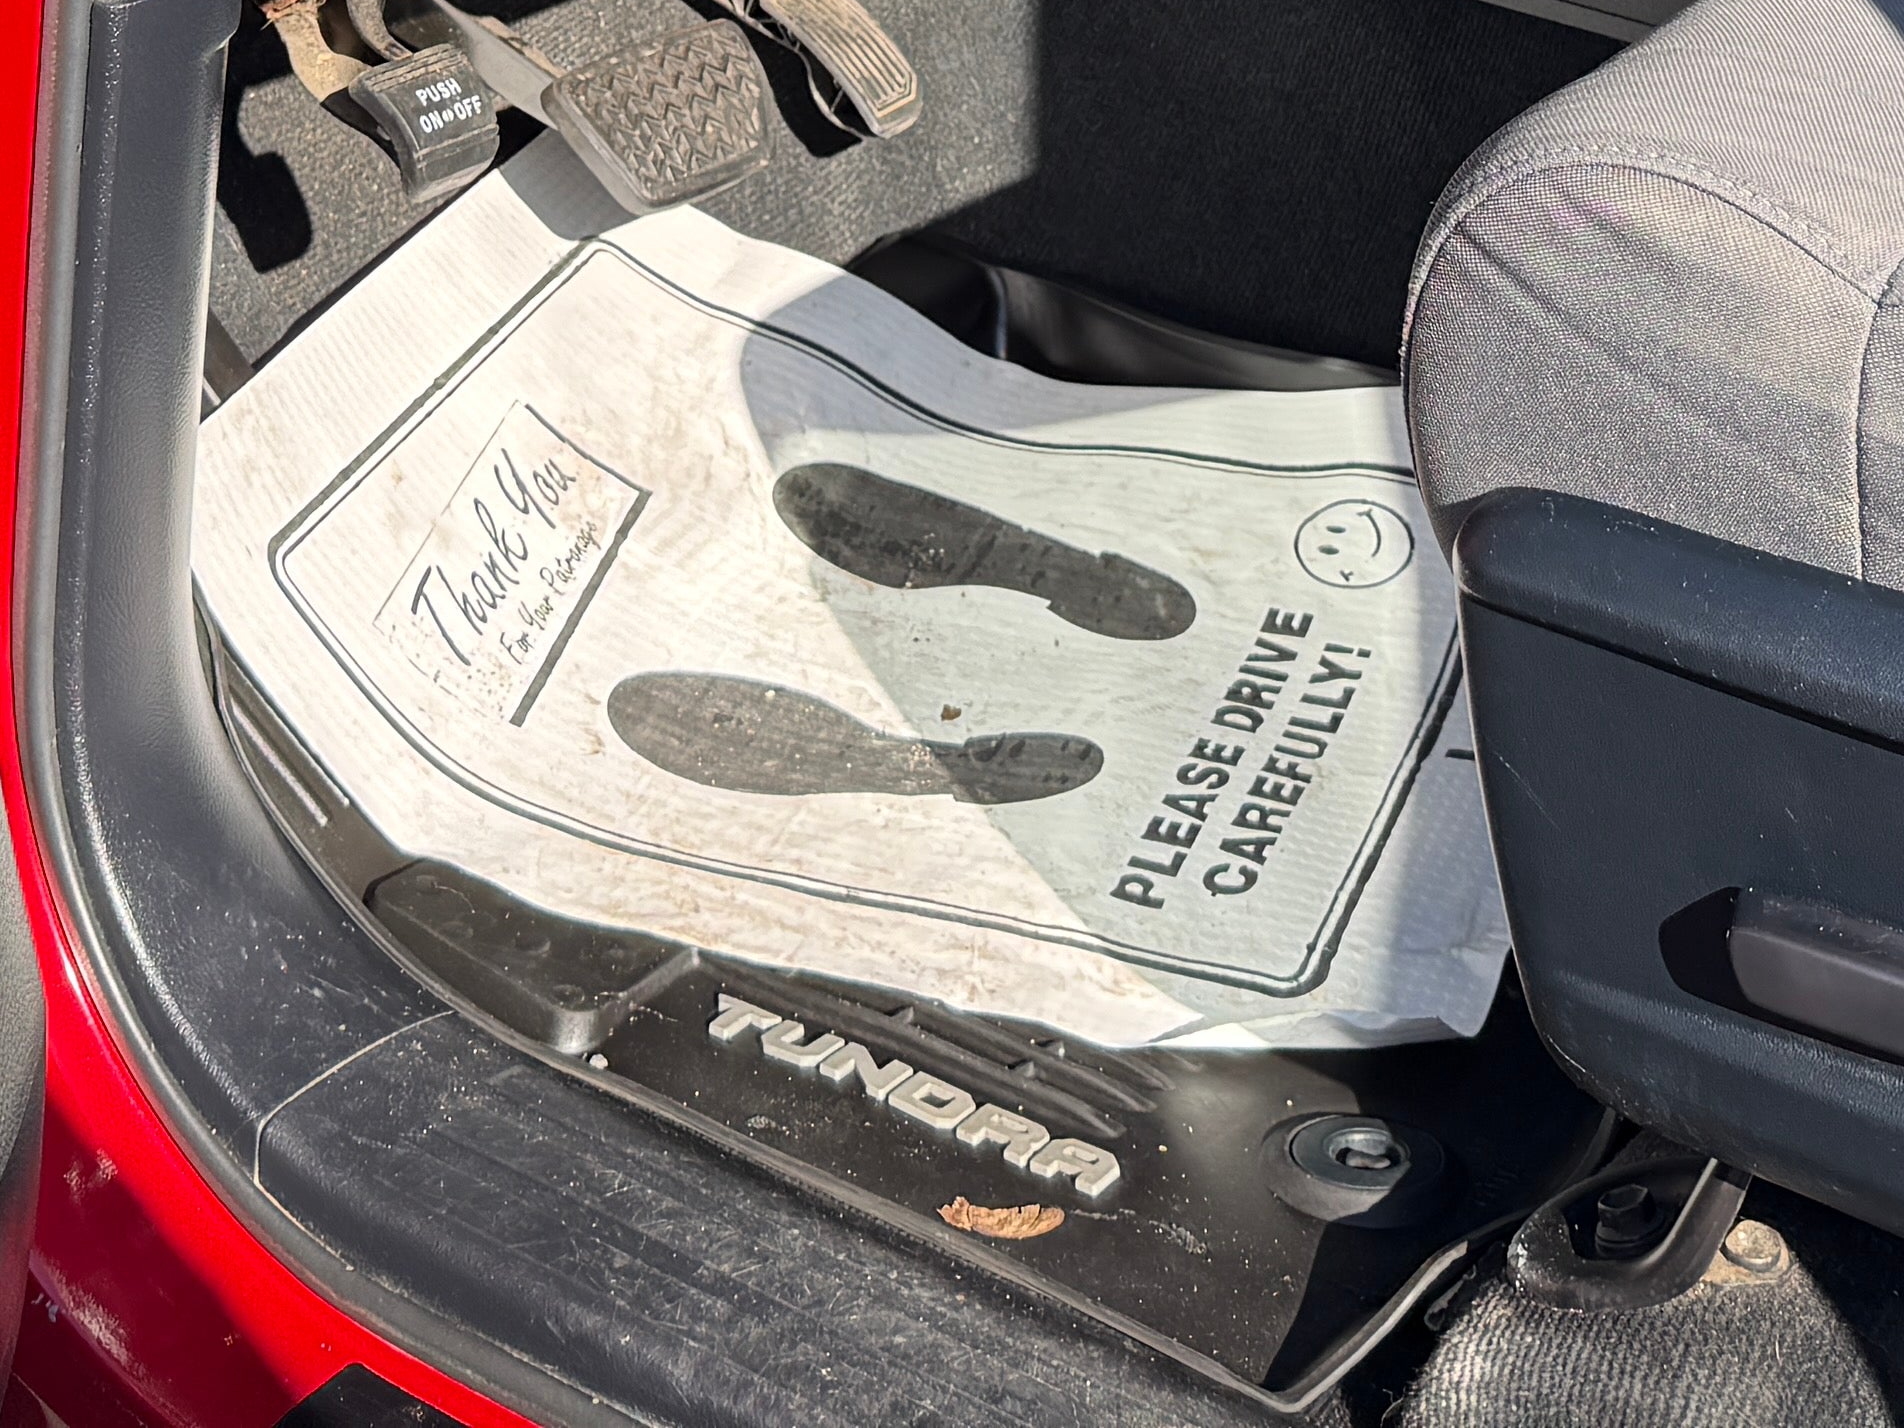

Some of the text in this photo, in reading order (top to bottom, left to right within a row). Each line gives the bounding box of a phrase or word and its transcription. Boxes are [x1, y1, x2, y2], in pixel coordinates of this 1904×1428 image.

[415, 77, 462, 107] PUSH
[419, 95, 483, 134] ON OFF
[411, 447, 577, 667] Thank You
[500, 631, 534, 665] For
[520, 595, 555, 631] Your
[1109, 607, 1315, 910] PLEASE DRIVE
[1202, 642, 1372, 896] CAREFULLY!
[709, 992, 1121, 1198] TUNDRA
